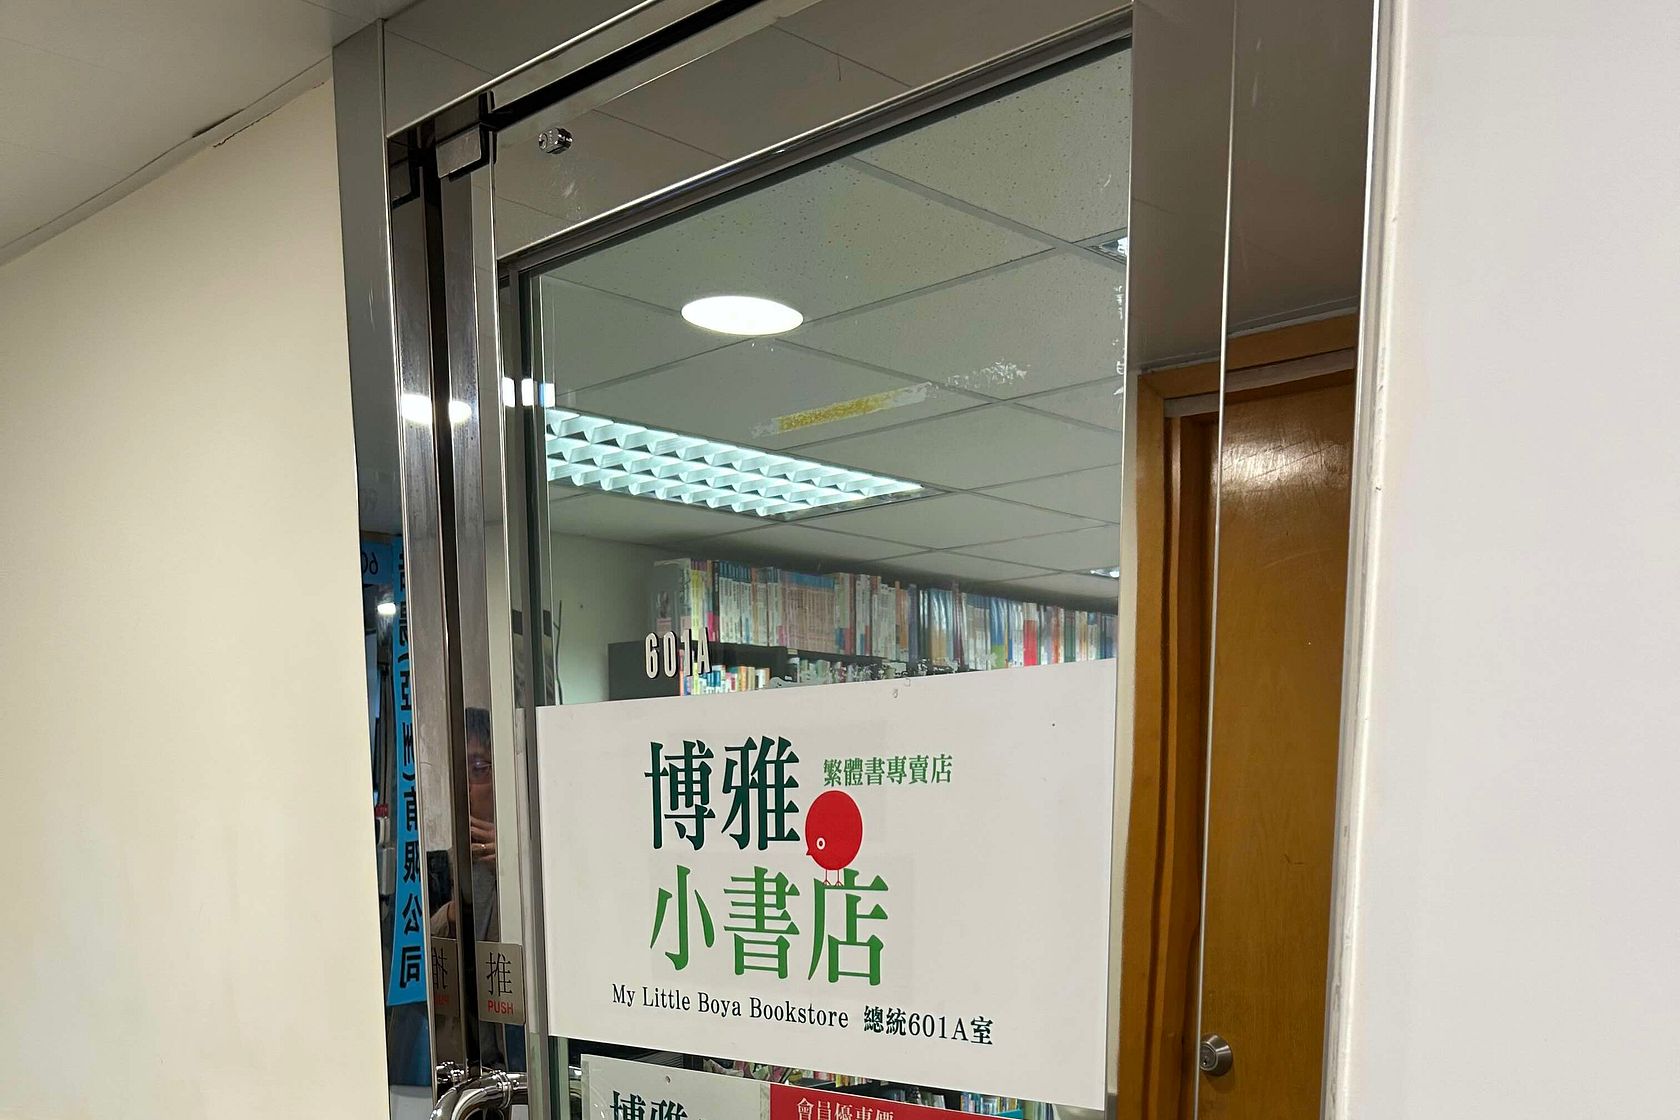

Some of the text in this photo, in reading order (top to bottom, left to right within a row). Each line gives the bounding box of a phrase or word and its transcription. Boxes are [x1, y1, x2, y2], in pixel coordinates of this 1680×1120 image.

[645, 627, 712, 680] 601A
[823, 754, 953, 787] 繁體書專賣店
[644, 735, 801, 852] 博雅
[649, 865, 889, 986] 小書店
[486, 952, 513, 996] 推
[488, 999, 513, 1015] PUSH
[612, 983, 635, 1007] My
[642, 986, 690, 1010] Little
[698, 992, 742, 1017] Boya
[750, 997, 849, 1028] Bookstore
